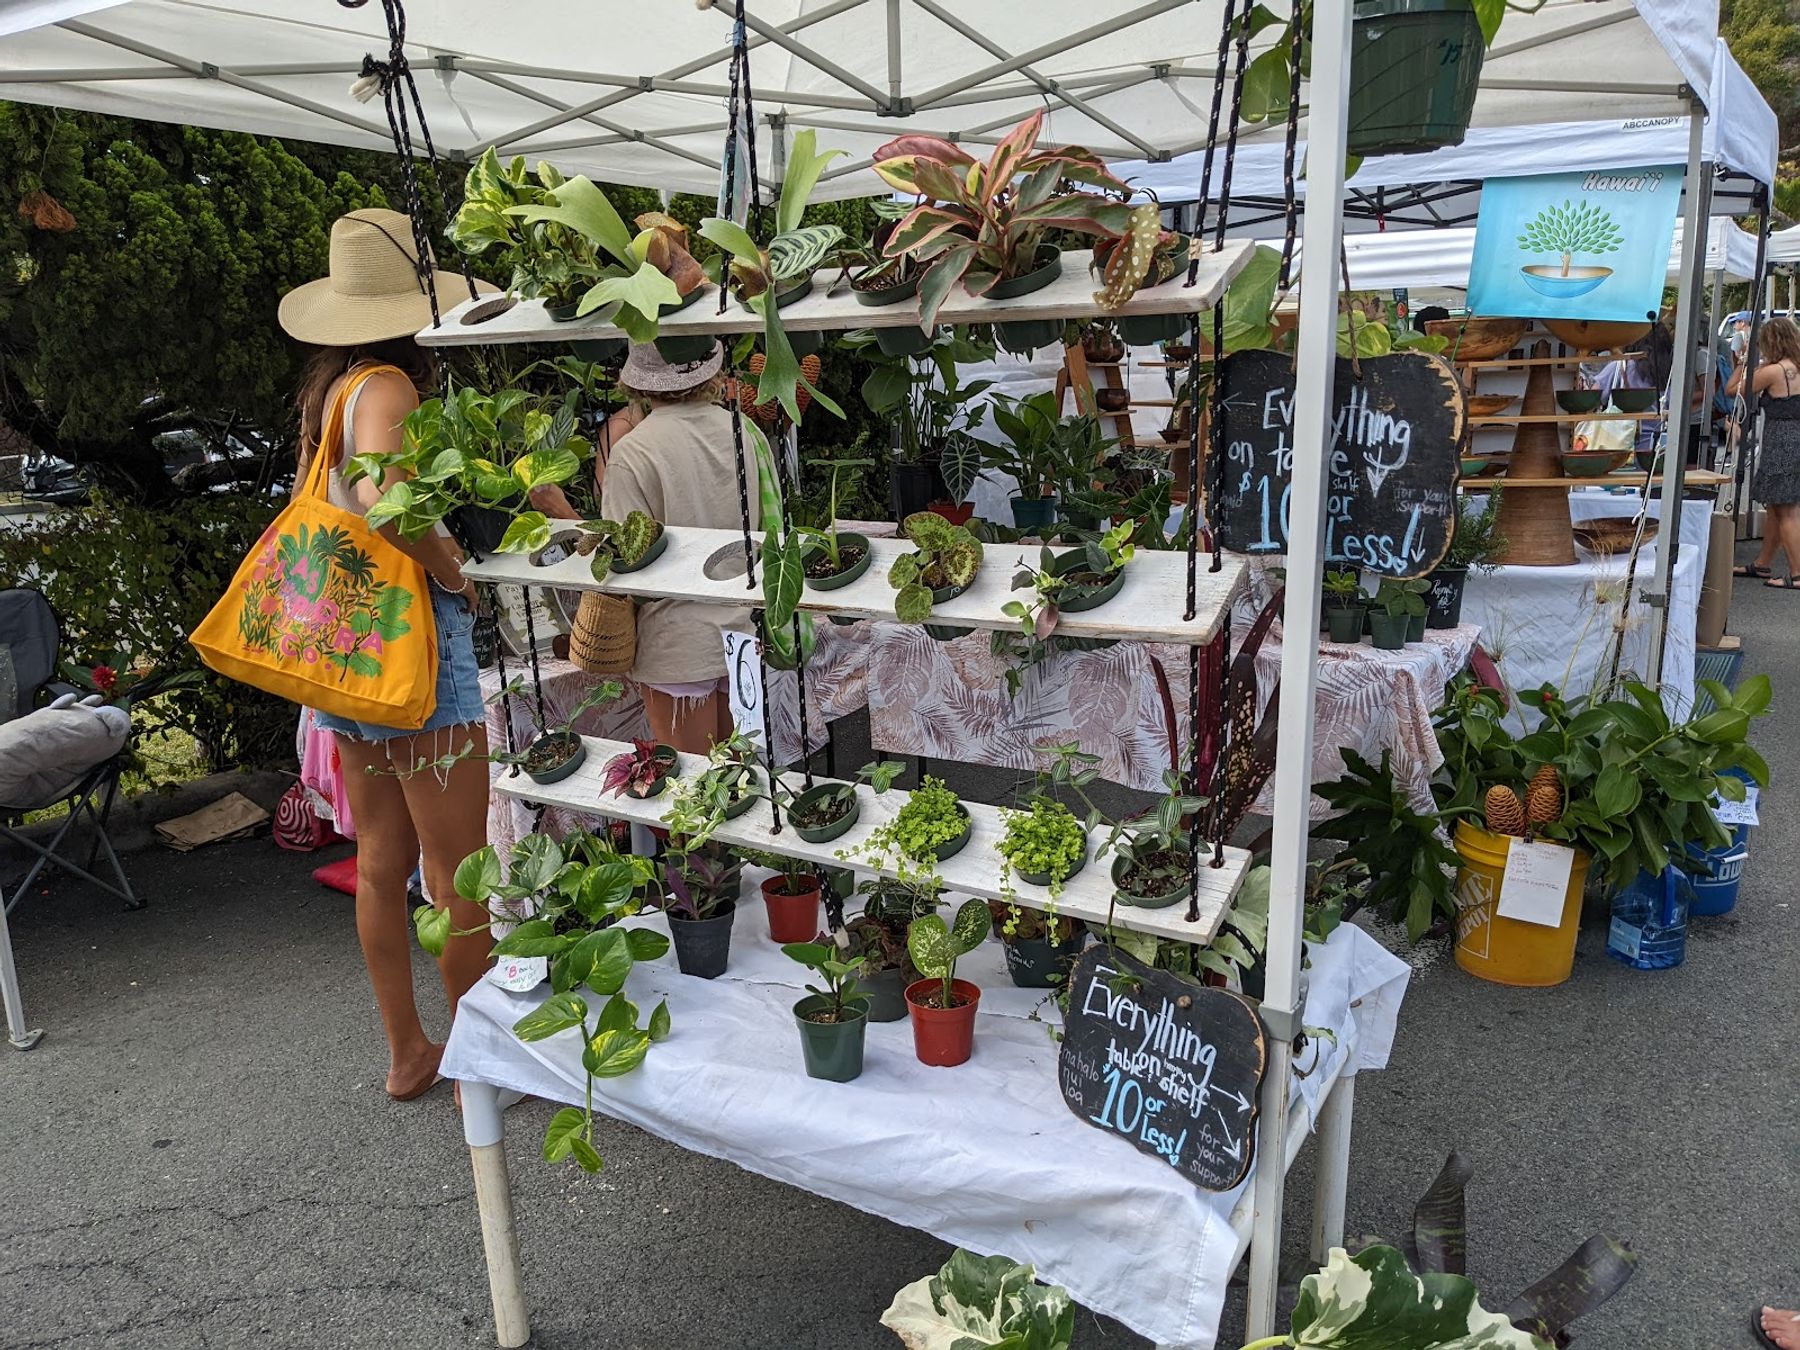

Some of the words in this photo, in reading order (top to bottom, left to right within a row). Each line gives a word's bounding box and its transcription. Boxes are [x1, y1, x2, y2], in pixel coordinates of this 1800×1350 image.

[1622, 117, 1680, 130] ABCCANOPY
[1262, 385, 1411, 470] Evything
[1228, 440, 1254, 474] on
[1327, 495, 1354, 516] or
[1083, 965, 1217, 1089] Everything
[1061, 1047, 1100, 1082] mahalo
[1063, 1065, 1083, 1089] nui
[1137, 1052, 1161, 1077] on
[1105, 1038, 1143, 1078] table
[1158, 1075, 1211, 1118] shelf
[1065, 1080, 1084, 1105] loa
[1144, 1096, 1168, 1114] or
[1198, 1123, 1221, 1149] for
[1196, 1142, 1226, 1166] your
